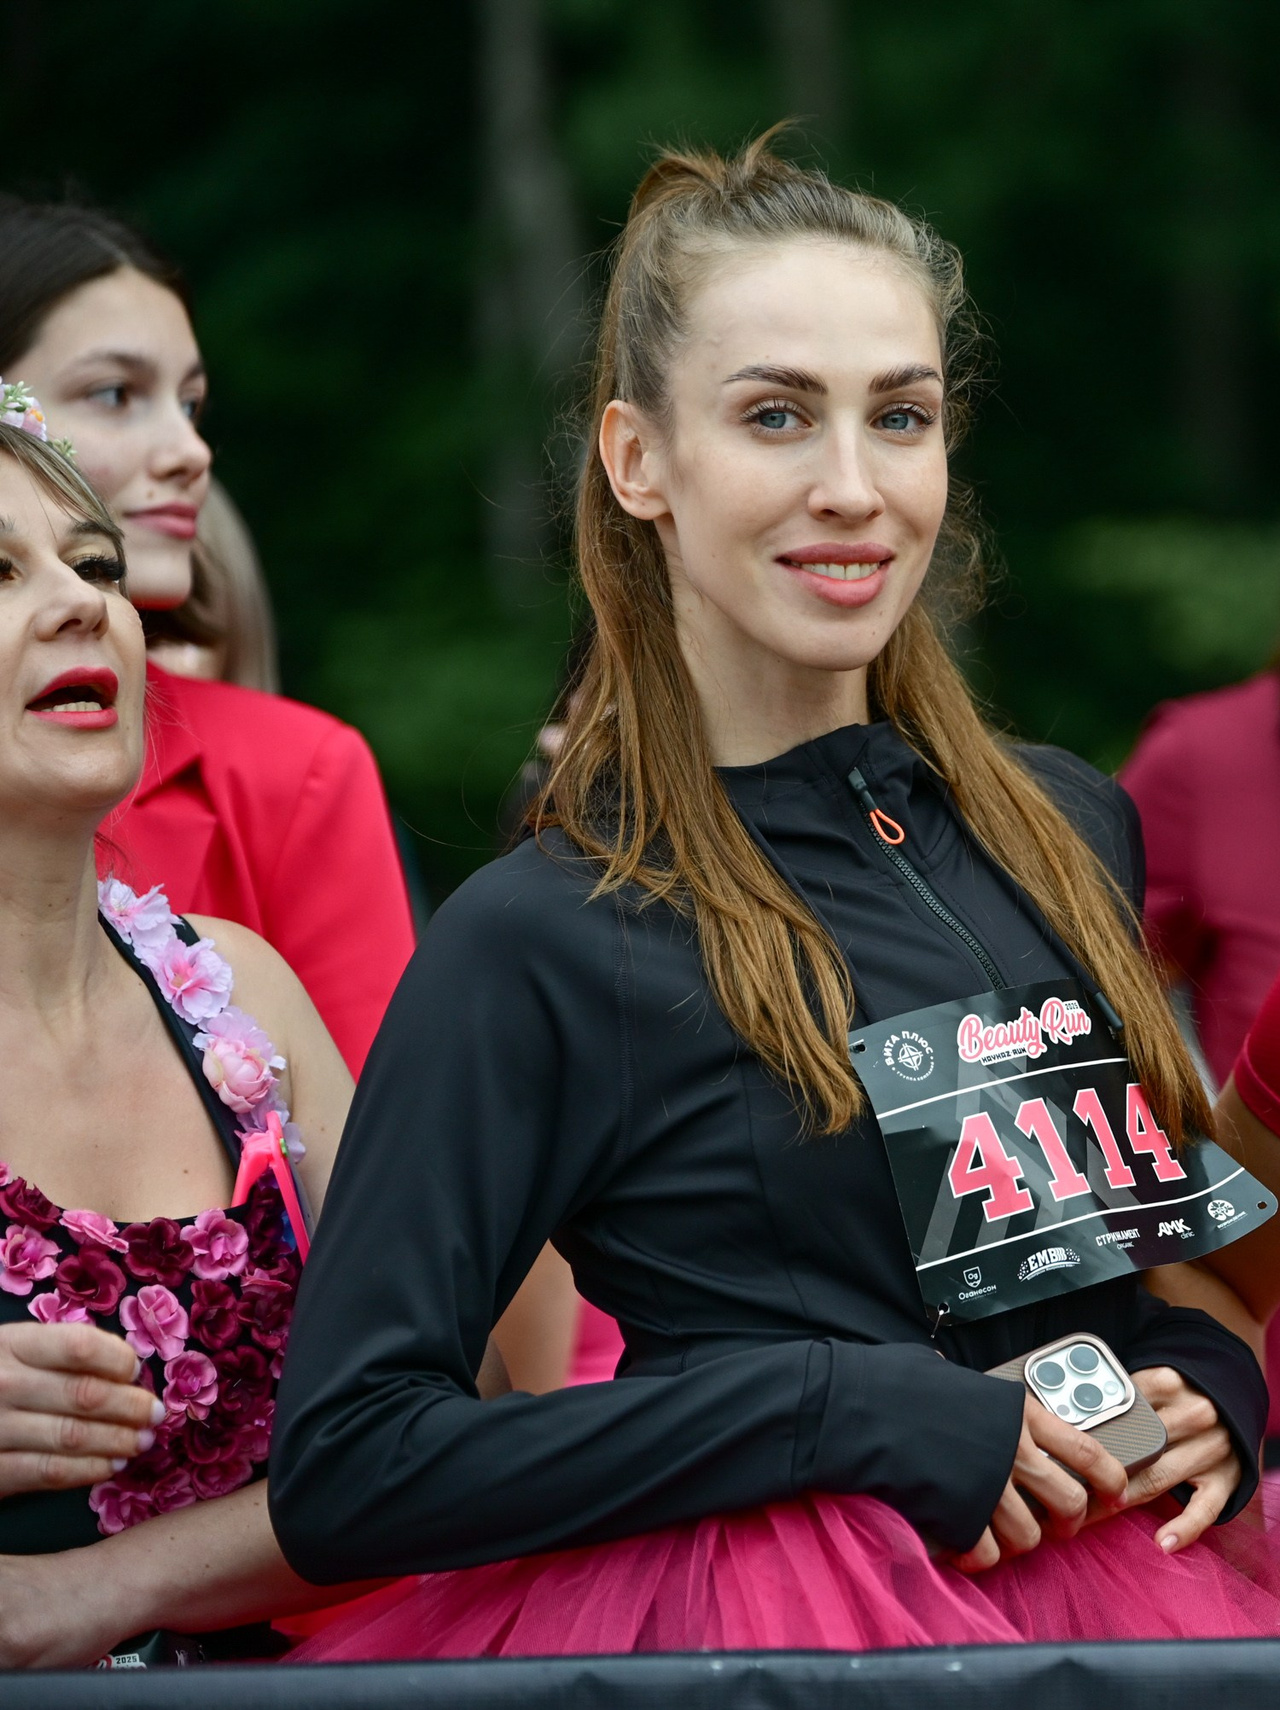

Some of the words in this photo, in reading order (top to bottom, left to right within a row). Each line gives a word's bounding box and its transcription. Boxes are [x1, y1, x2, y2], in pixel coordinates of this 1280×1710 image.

[883, 1034, 901, 1067] ВИТА
[902, 1030, 934, 1055] ПЛЮС
[957, 1007, 1045, 1060] Beauty
[1041, 1000, 1090, 1043] Run
[948, 1083, 1187, 1223] 4114
[116, 1655, 137, 1665] 2025
